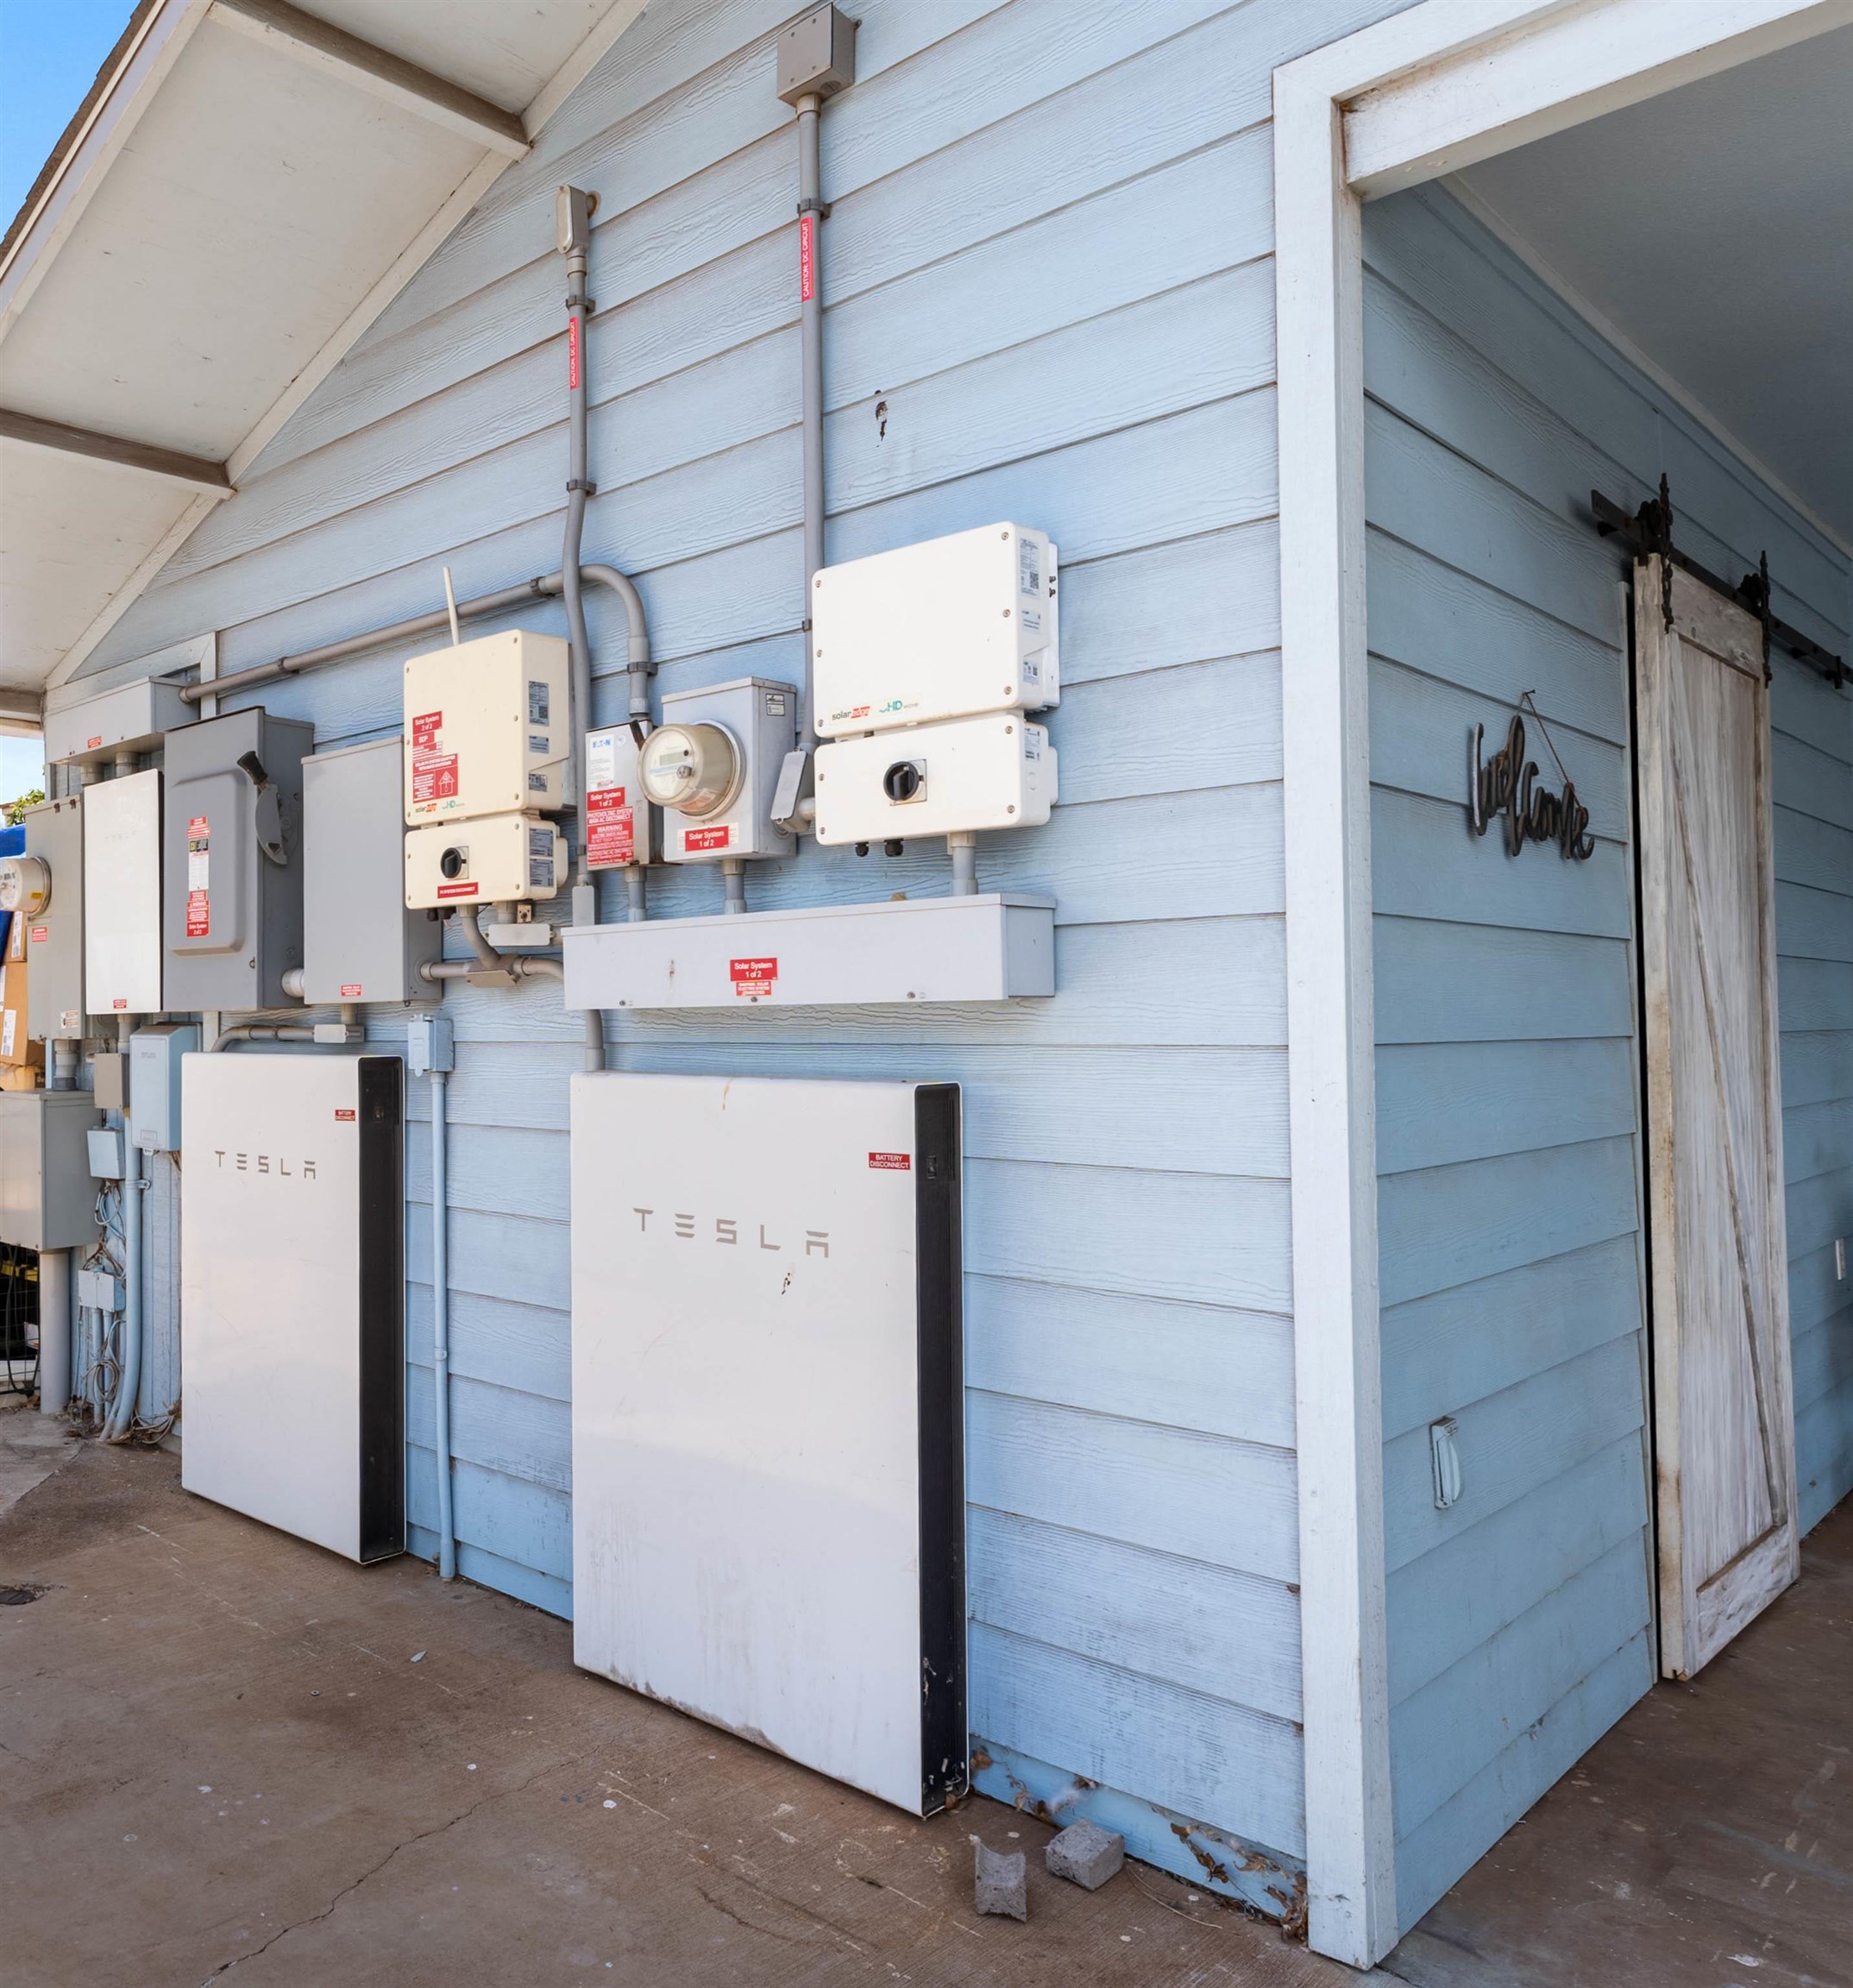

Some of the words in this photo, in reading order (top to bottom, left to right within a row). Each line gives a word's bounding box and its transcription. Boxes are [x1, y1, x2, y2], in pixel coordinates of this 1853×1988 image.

[597, 824, 623, 834] WARNING
[215, 1150, 316, 1180] TESLA
[633, 1208, 829, 1258] TESLA
